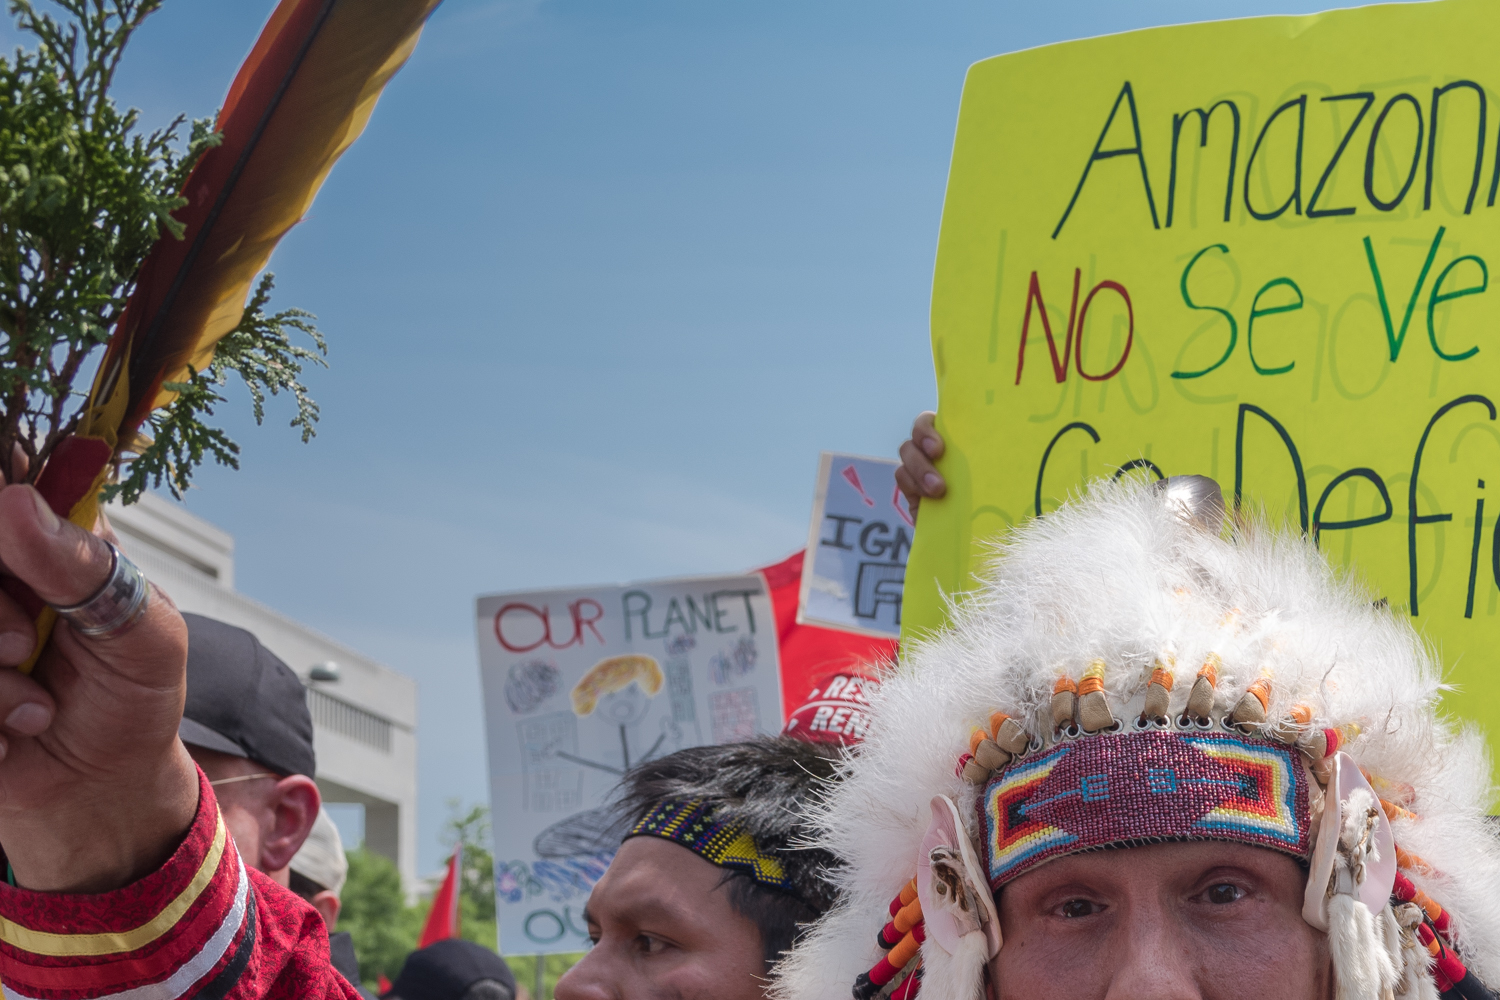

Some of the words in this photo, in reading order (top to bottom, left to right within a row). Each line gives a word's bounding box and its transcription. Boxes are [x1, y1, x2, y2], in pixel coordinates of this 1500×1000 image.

[1170, 242, 1304, 380] Se
[493, 597, 606, 653] OUR
[621, 589, 761, 643] PLANET
